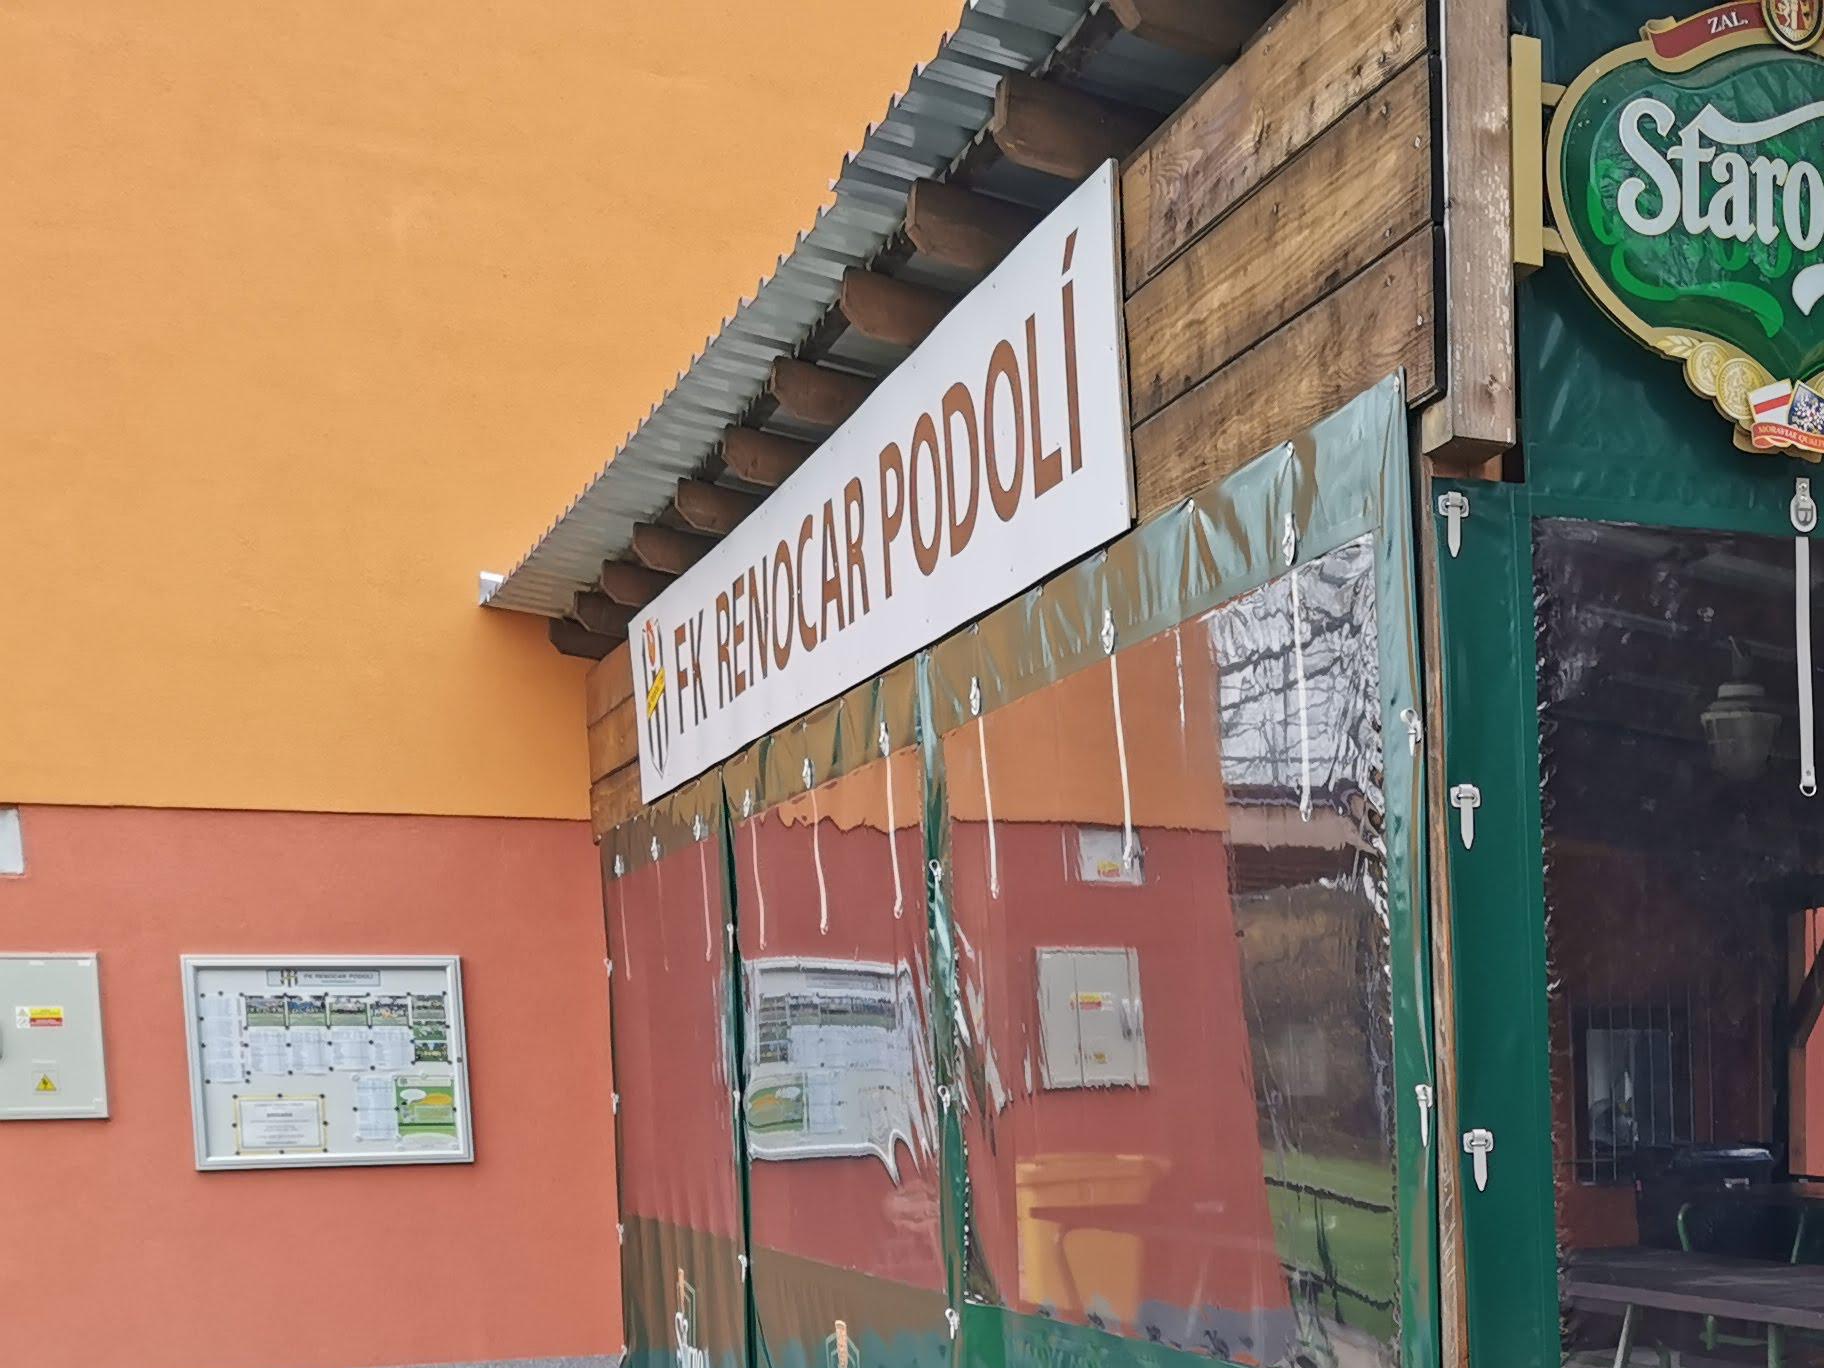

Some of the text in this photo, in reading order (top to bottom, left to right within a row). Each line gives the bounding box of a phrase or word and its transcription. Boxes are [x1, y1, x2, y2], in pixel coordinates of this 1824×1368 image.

[1706, 11, 1749, 35] ZAL.
[673, 227, 1083, 735] FK RENOCAR PODOLÍ
